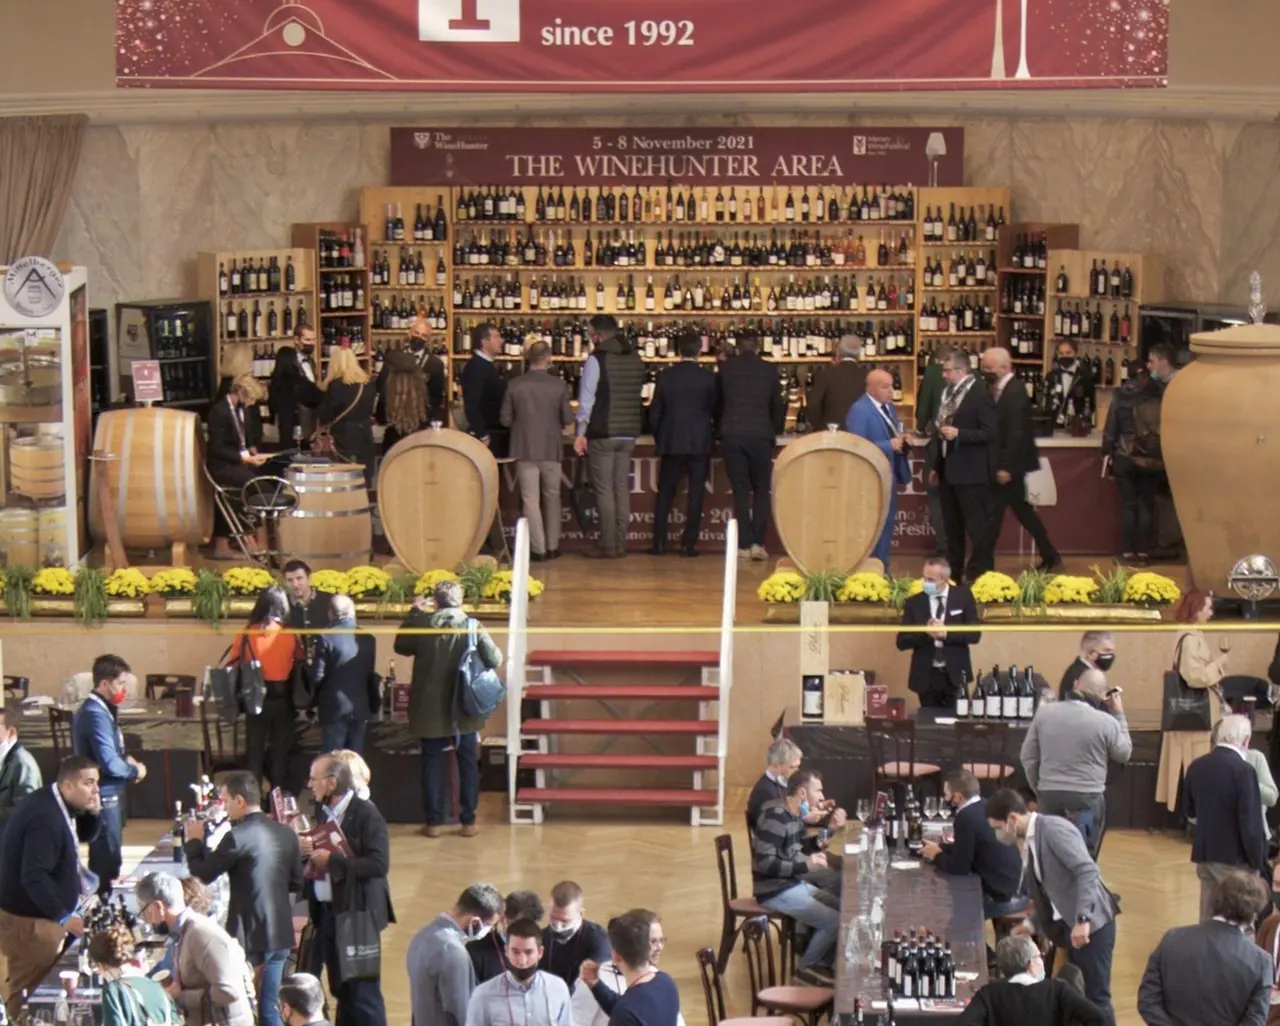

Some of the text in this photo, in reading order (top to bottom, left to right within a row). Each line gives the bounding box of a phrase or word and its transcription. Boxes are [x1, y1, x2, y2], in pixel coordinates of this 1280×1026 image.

[540, 17, 695, 46] since 1992
[434, 131, 452, 141] The
[592, 136, 602, 149] 5
[617, 136, 627, 149] 8
[632, 135, 713, 150] November
[717, 135, 754, 150] 2021
[505, 154, 844, 177] THE WINEHUNTER AREA
